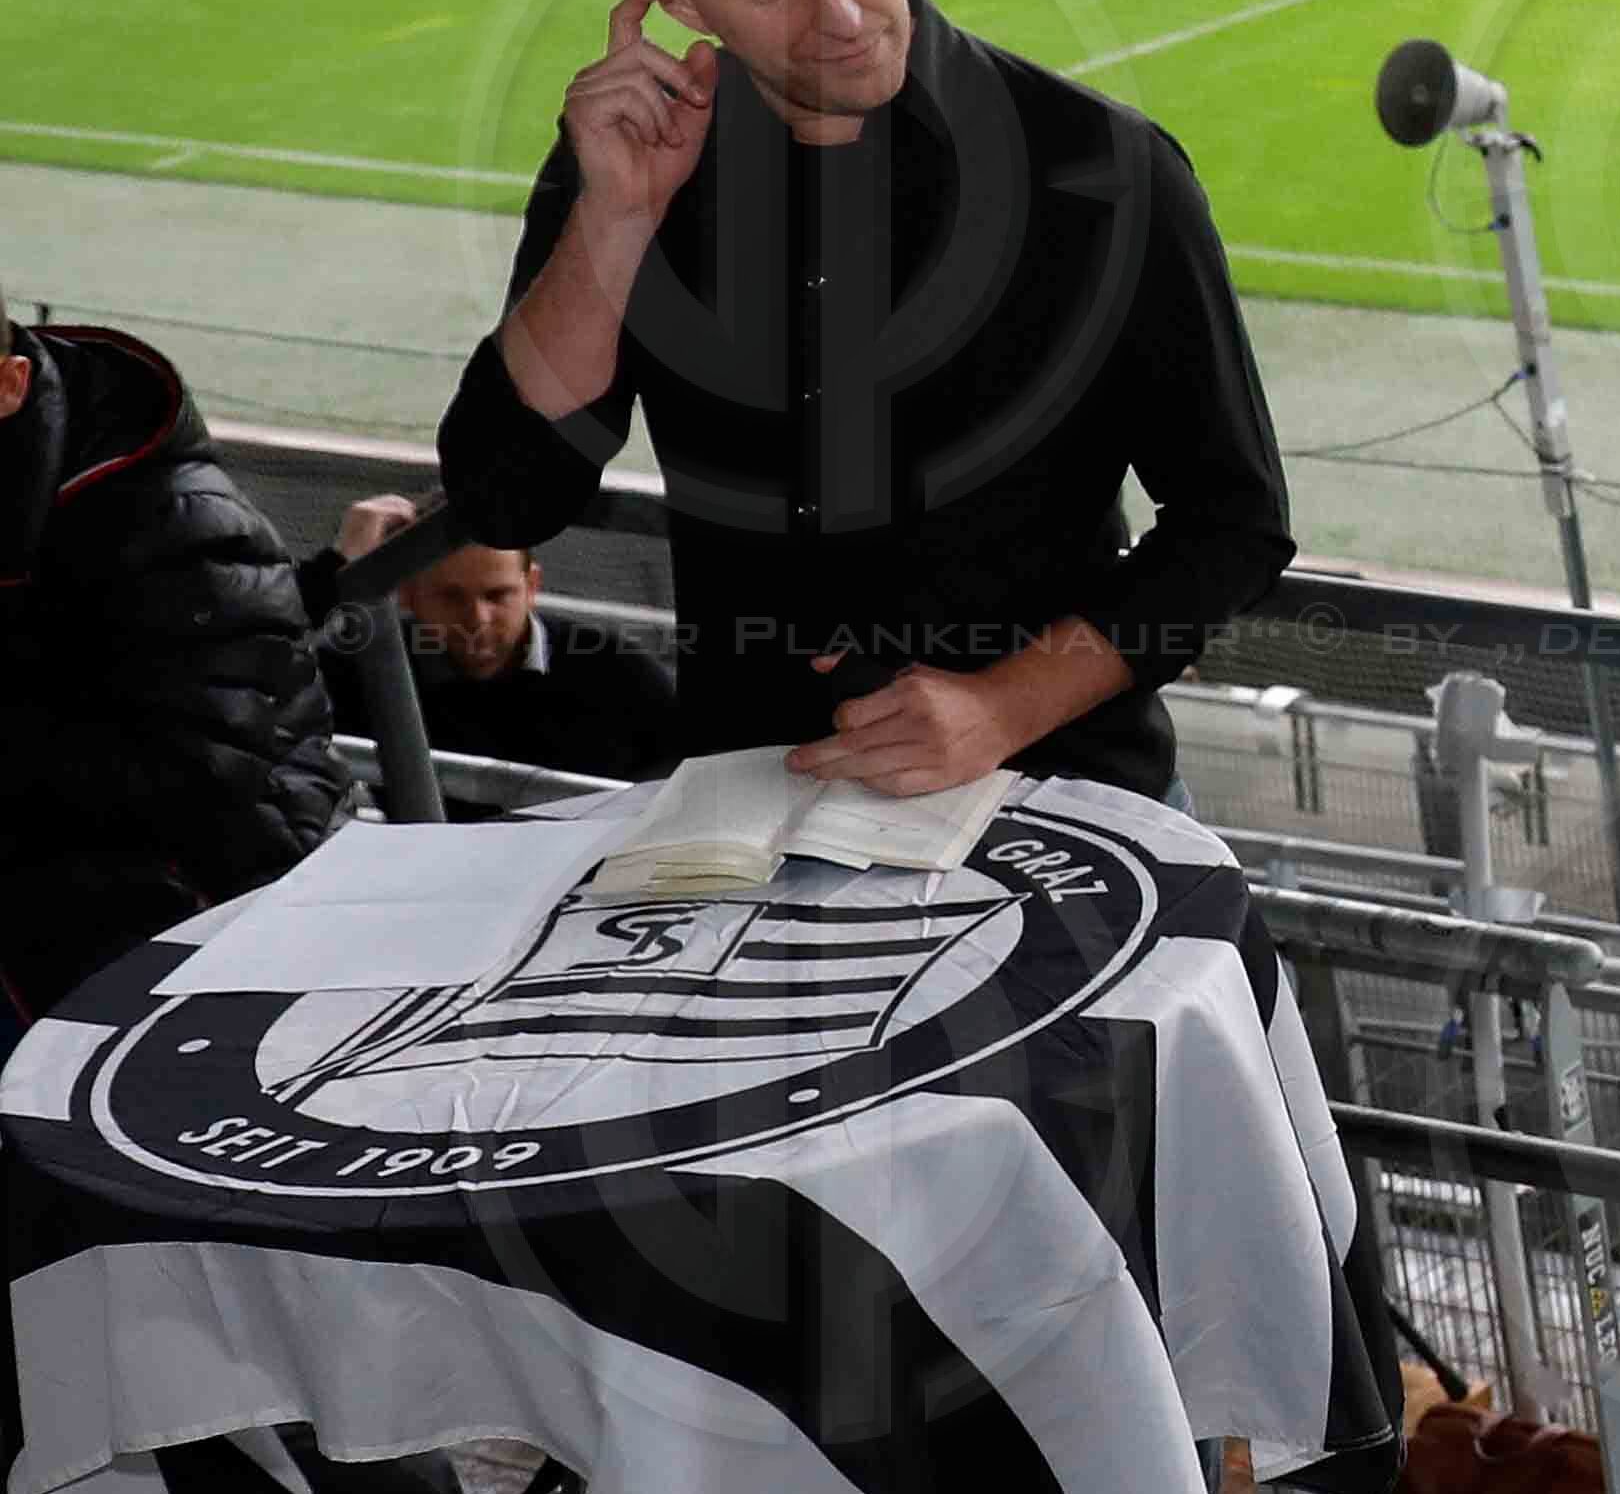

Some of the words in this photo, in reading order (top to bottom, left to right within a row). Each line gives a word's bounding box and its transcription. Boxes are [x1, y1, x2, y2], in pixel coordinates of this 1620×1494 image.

[987, 839, 1110, 903] GRAZ
[177, 1116, 329, 1169] SEIT
[336, 1140, 542, 1177] 1909
